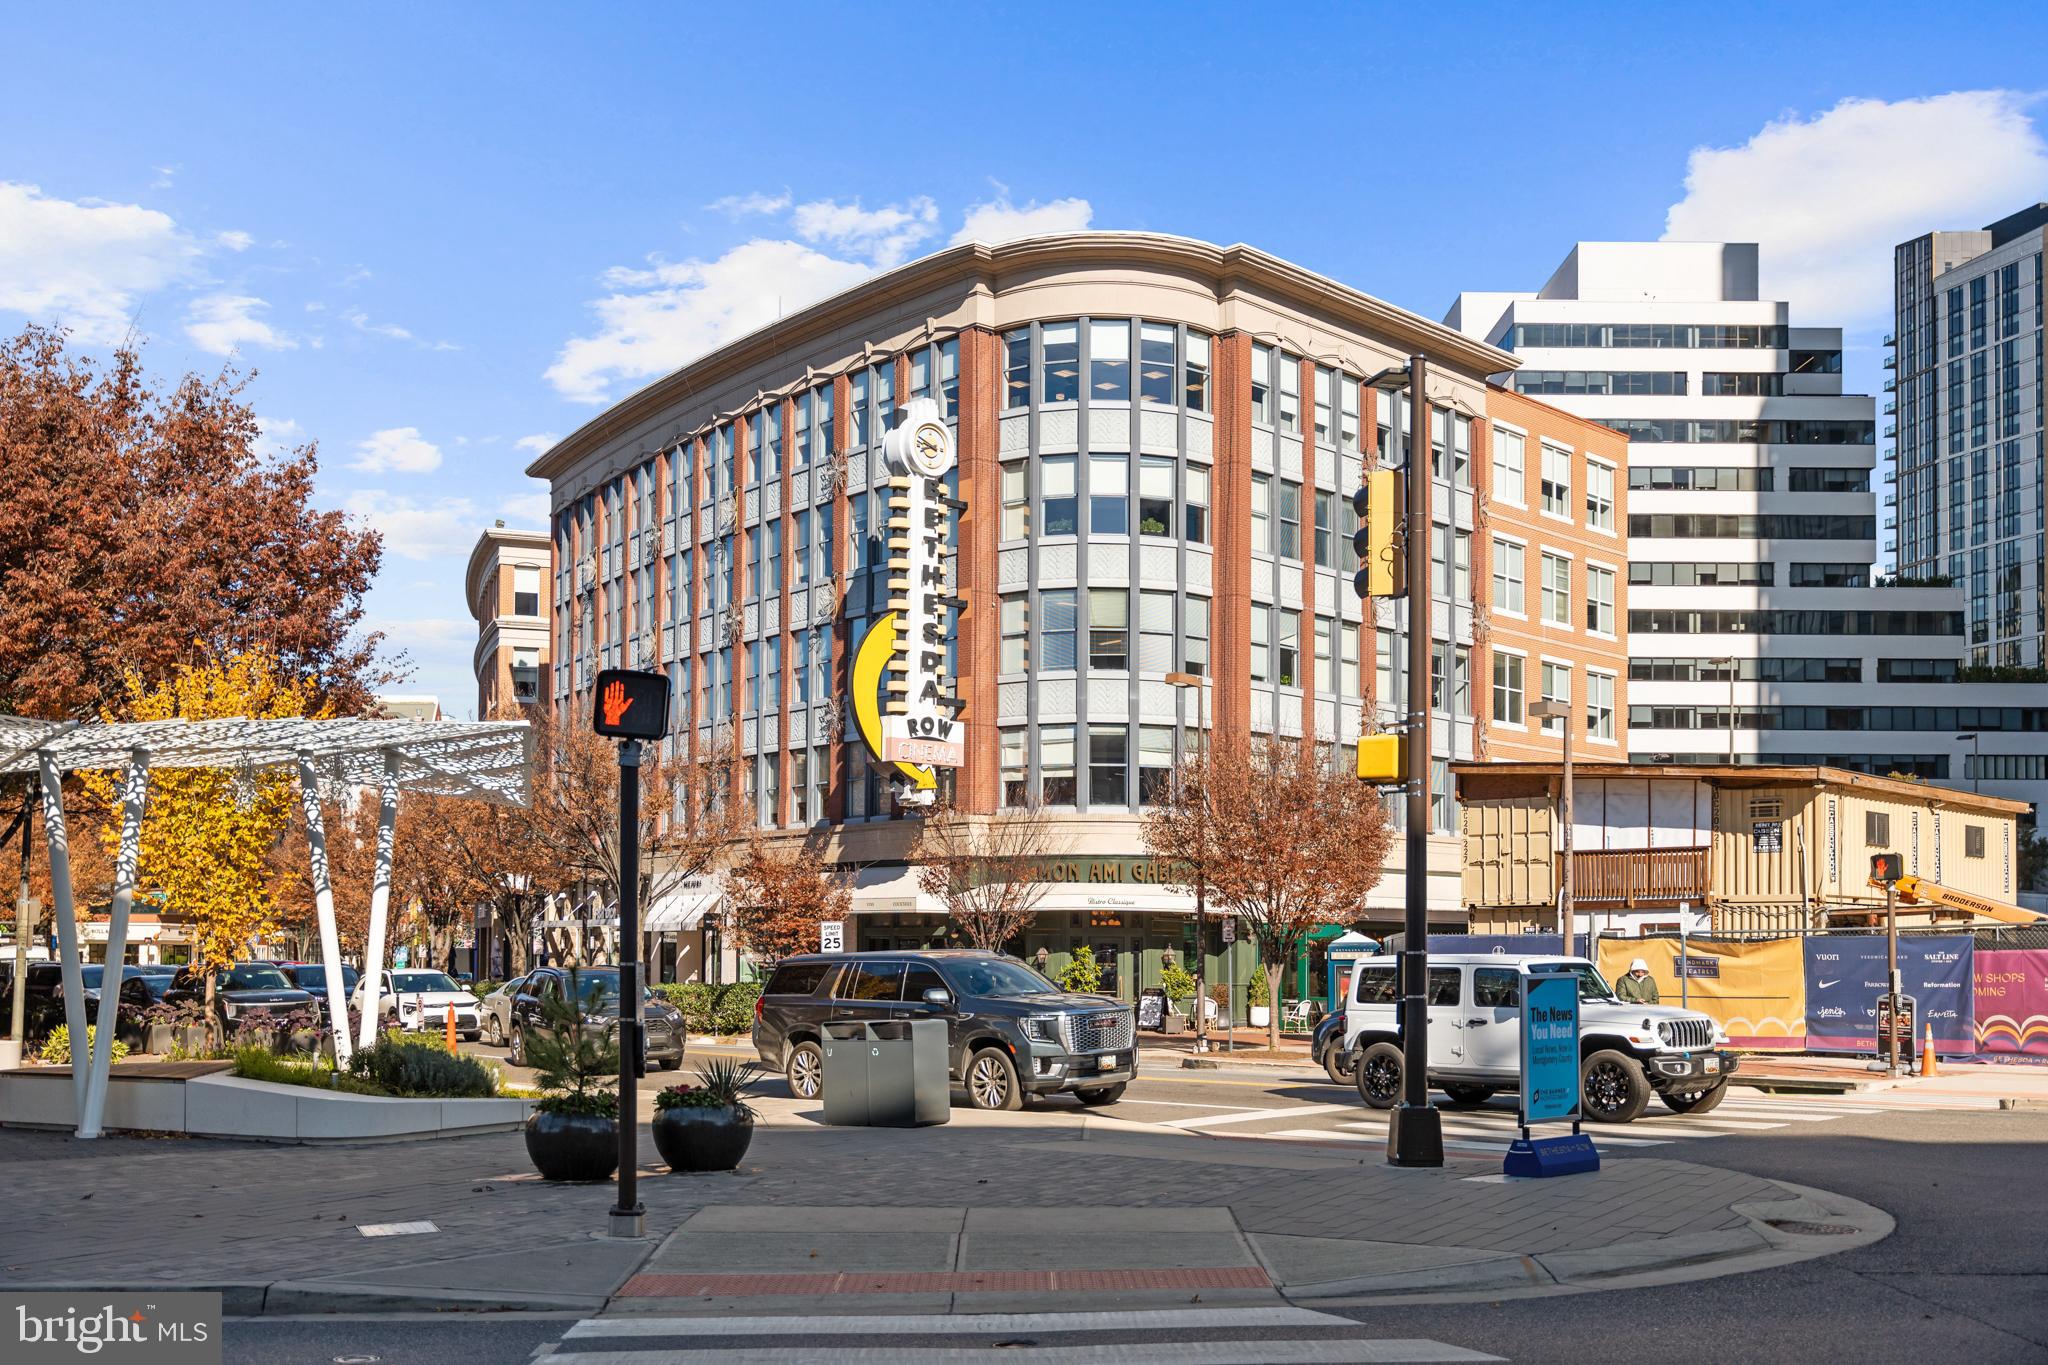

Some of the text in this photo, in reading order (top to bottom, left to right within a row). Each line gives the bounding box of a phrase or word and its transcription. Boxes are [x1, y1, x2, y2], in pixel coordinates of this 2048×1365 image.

[920, 478, 942, 704] BETHESDA
[907, 716, 953, 739] ROW
[899, 742, 958, 763] CINEMA
[1036, 863, 1081, 883] MON
[1089, 863, 1125, 883] AMI
[1107, 897, 1135, 906] Classique
[1942, 893, 1994, 912] BRODERSON
[824, 938, 841, 948] 25
[1986, 973, 2025, 983] SHOPS
[1530, 1006, 1573, 1023] The News
[1531, 1022, 1573, 1040] You Need
